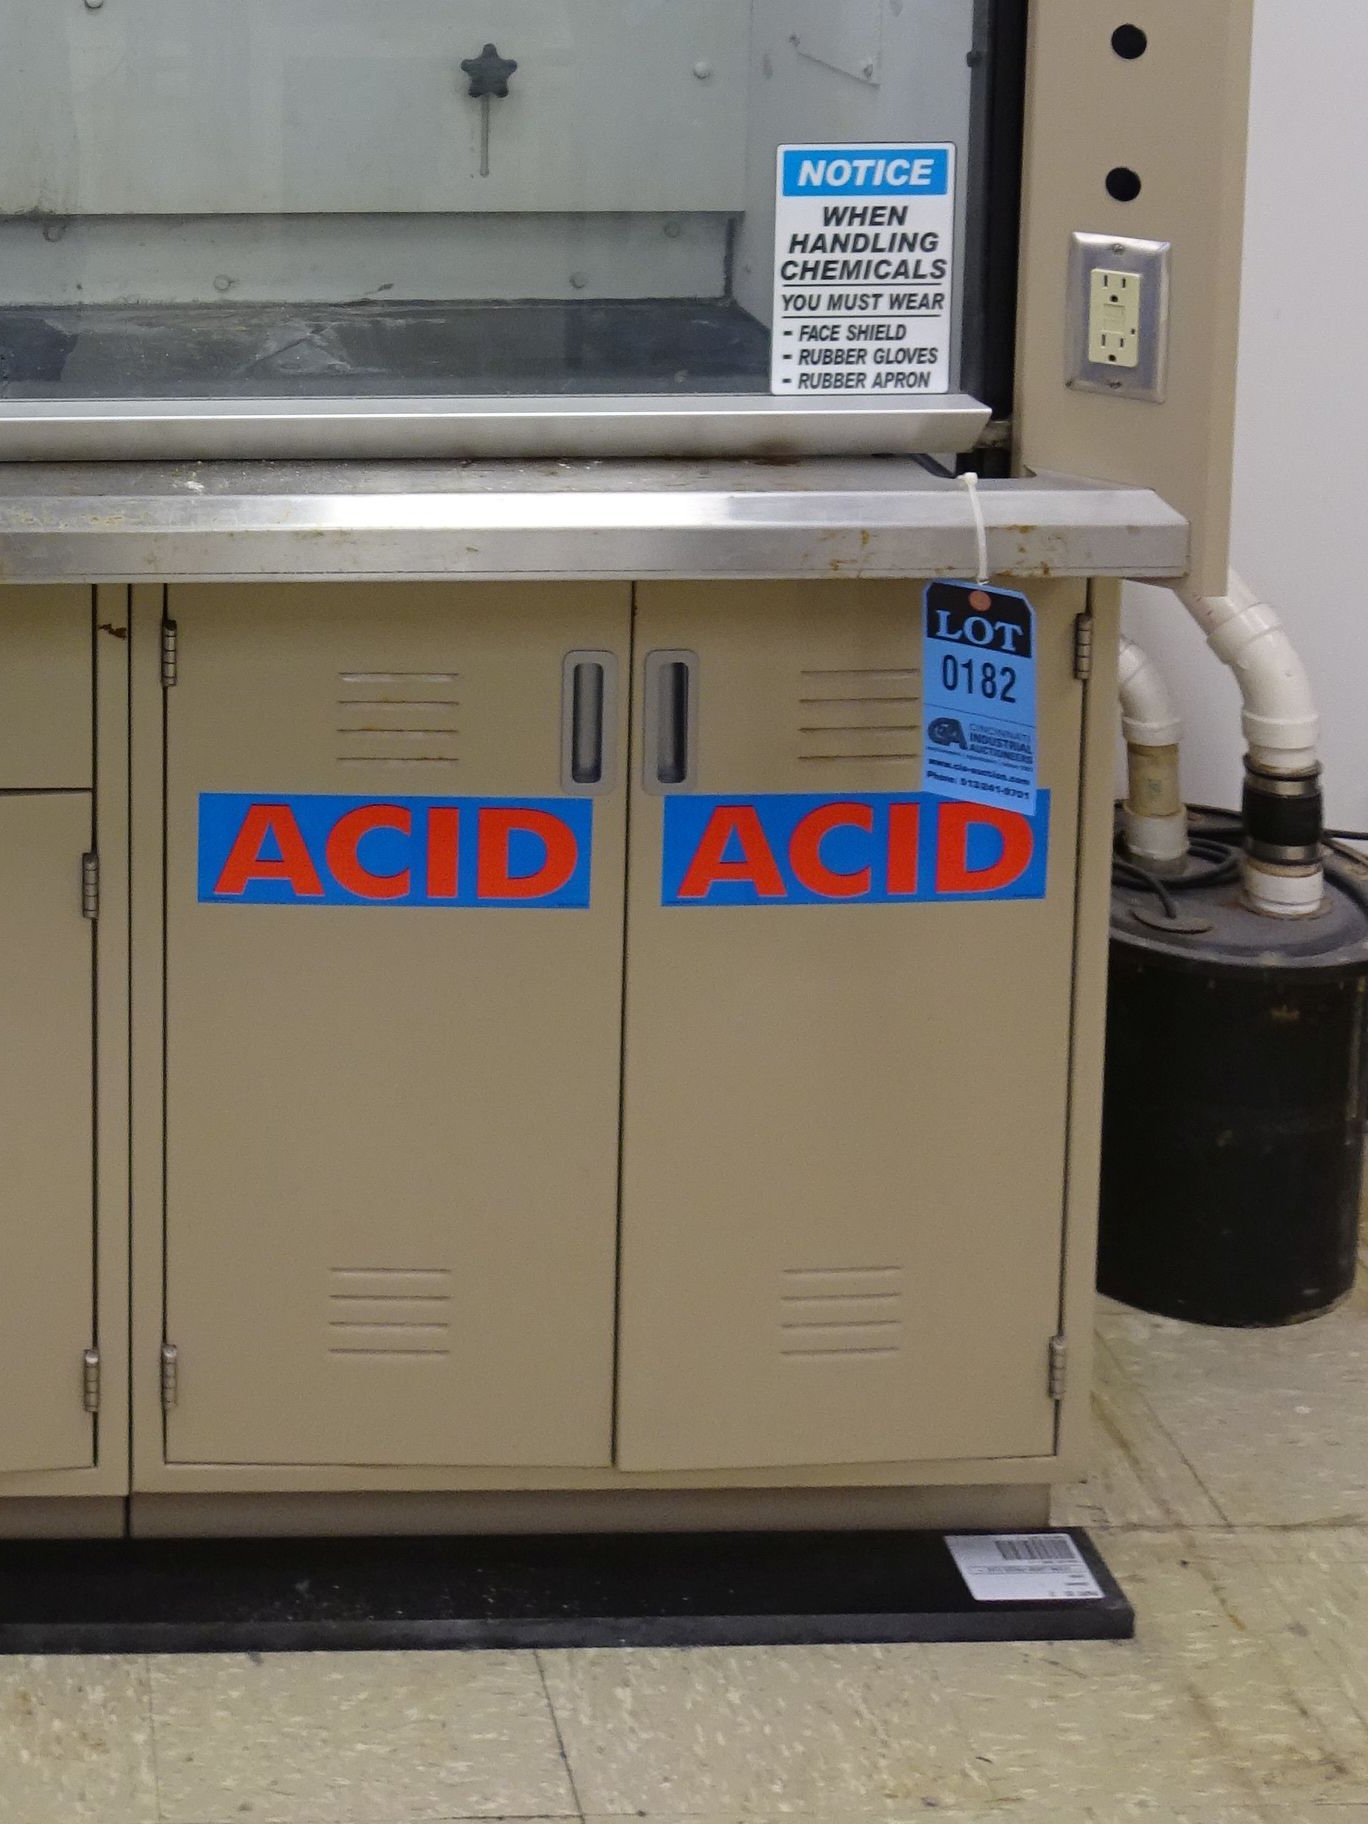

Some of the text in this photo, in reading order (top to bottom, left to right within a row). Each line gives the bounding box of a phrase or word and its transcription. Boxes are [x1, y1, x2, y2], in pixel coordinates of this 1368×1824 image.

[797, 159, 934, 187] NOTICE
[823, 205, 908, 227] WHEN
[788, 232, 940, 254] HANDLING
[781, 259, 948, 281] CHEMICALS
[782, 293, 945, 311] YOU MUST WEAR
[799, 325, 841, 342] FACE
[846, 324, 907, 341] SHIELD
[798, 348, 867, 365] RUBBER
[873, 347, 939, 365] GLOVES
[798, 372, 867, 390] RUBBER
[872, 371, 932, 389] APRON
[935, 609, 1024, 652] LOT
[942, 654, 1017, 704] 0182
[968, 743, 1033, 765] AUCTIONEERS
[969, 732, 1032, 754] INDUSTRIAL
[926, 770, 958, 784] Phone:
[213, 803, 579, 900] ACID
[676, 801, 1034, 899] ACID
